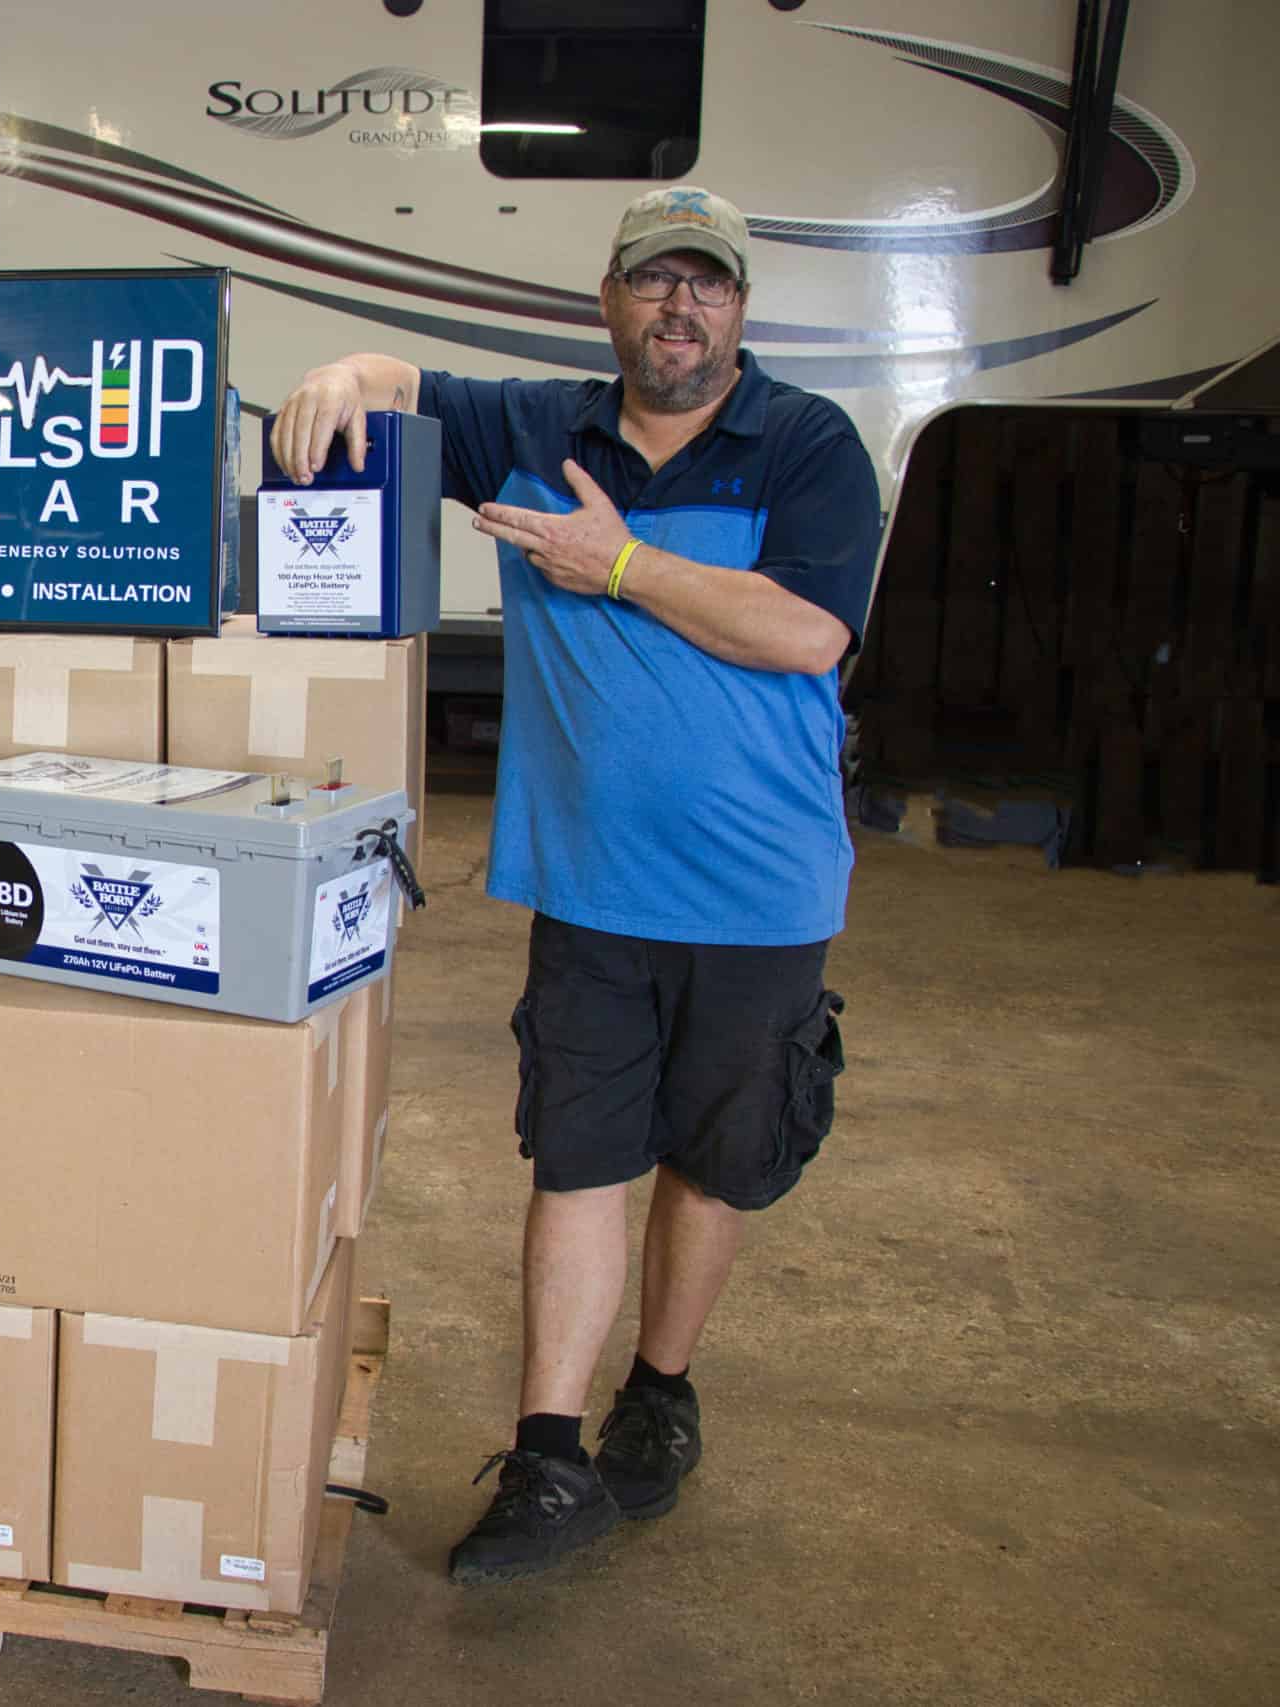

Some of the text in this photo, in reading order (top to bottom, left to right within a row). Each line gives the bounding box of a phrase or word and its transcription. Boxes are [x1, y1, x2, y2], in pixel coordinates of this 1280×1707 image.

[349, 130, 404, 145] GRAND
[90, 338, 204, 459] UP
[299, 520, 338, 529] BATTLE
[76, 546, 181, 561] SOLUTIONS
[32, 582, 192, 603] INSTALLATION
[92, 880, 140, 897] BATTLE
[99, 892, 134, 907] BORN
[74, 935, 85, 944] Get
[86, 937, 97, 946] out
[92, 959, 108, 970] 12V
[143, 967, 176, 983] Battery
